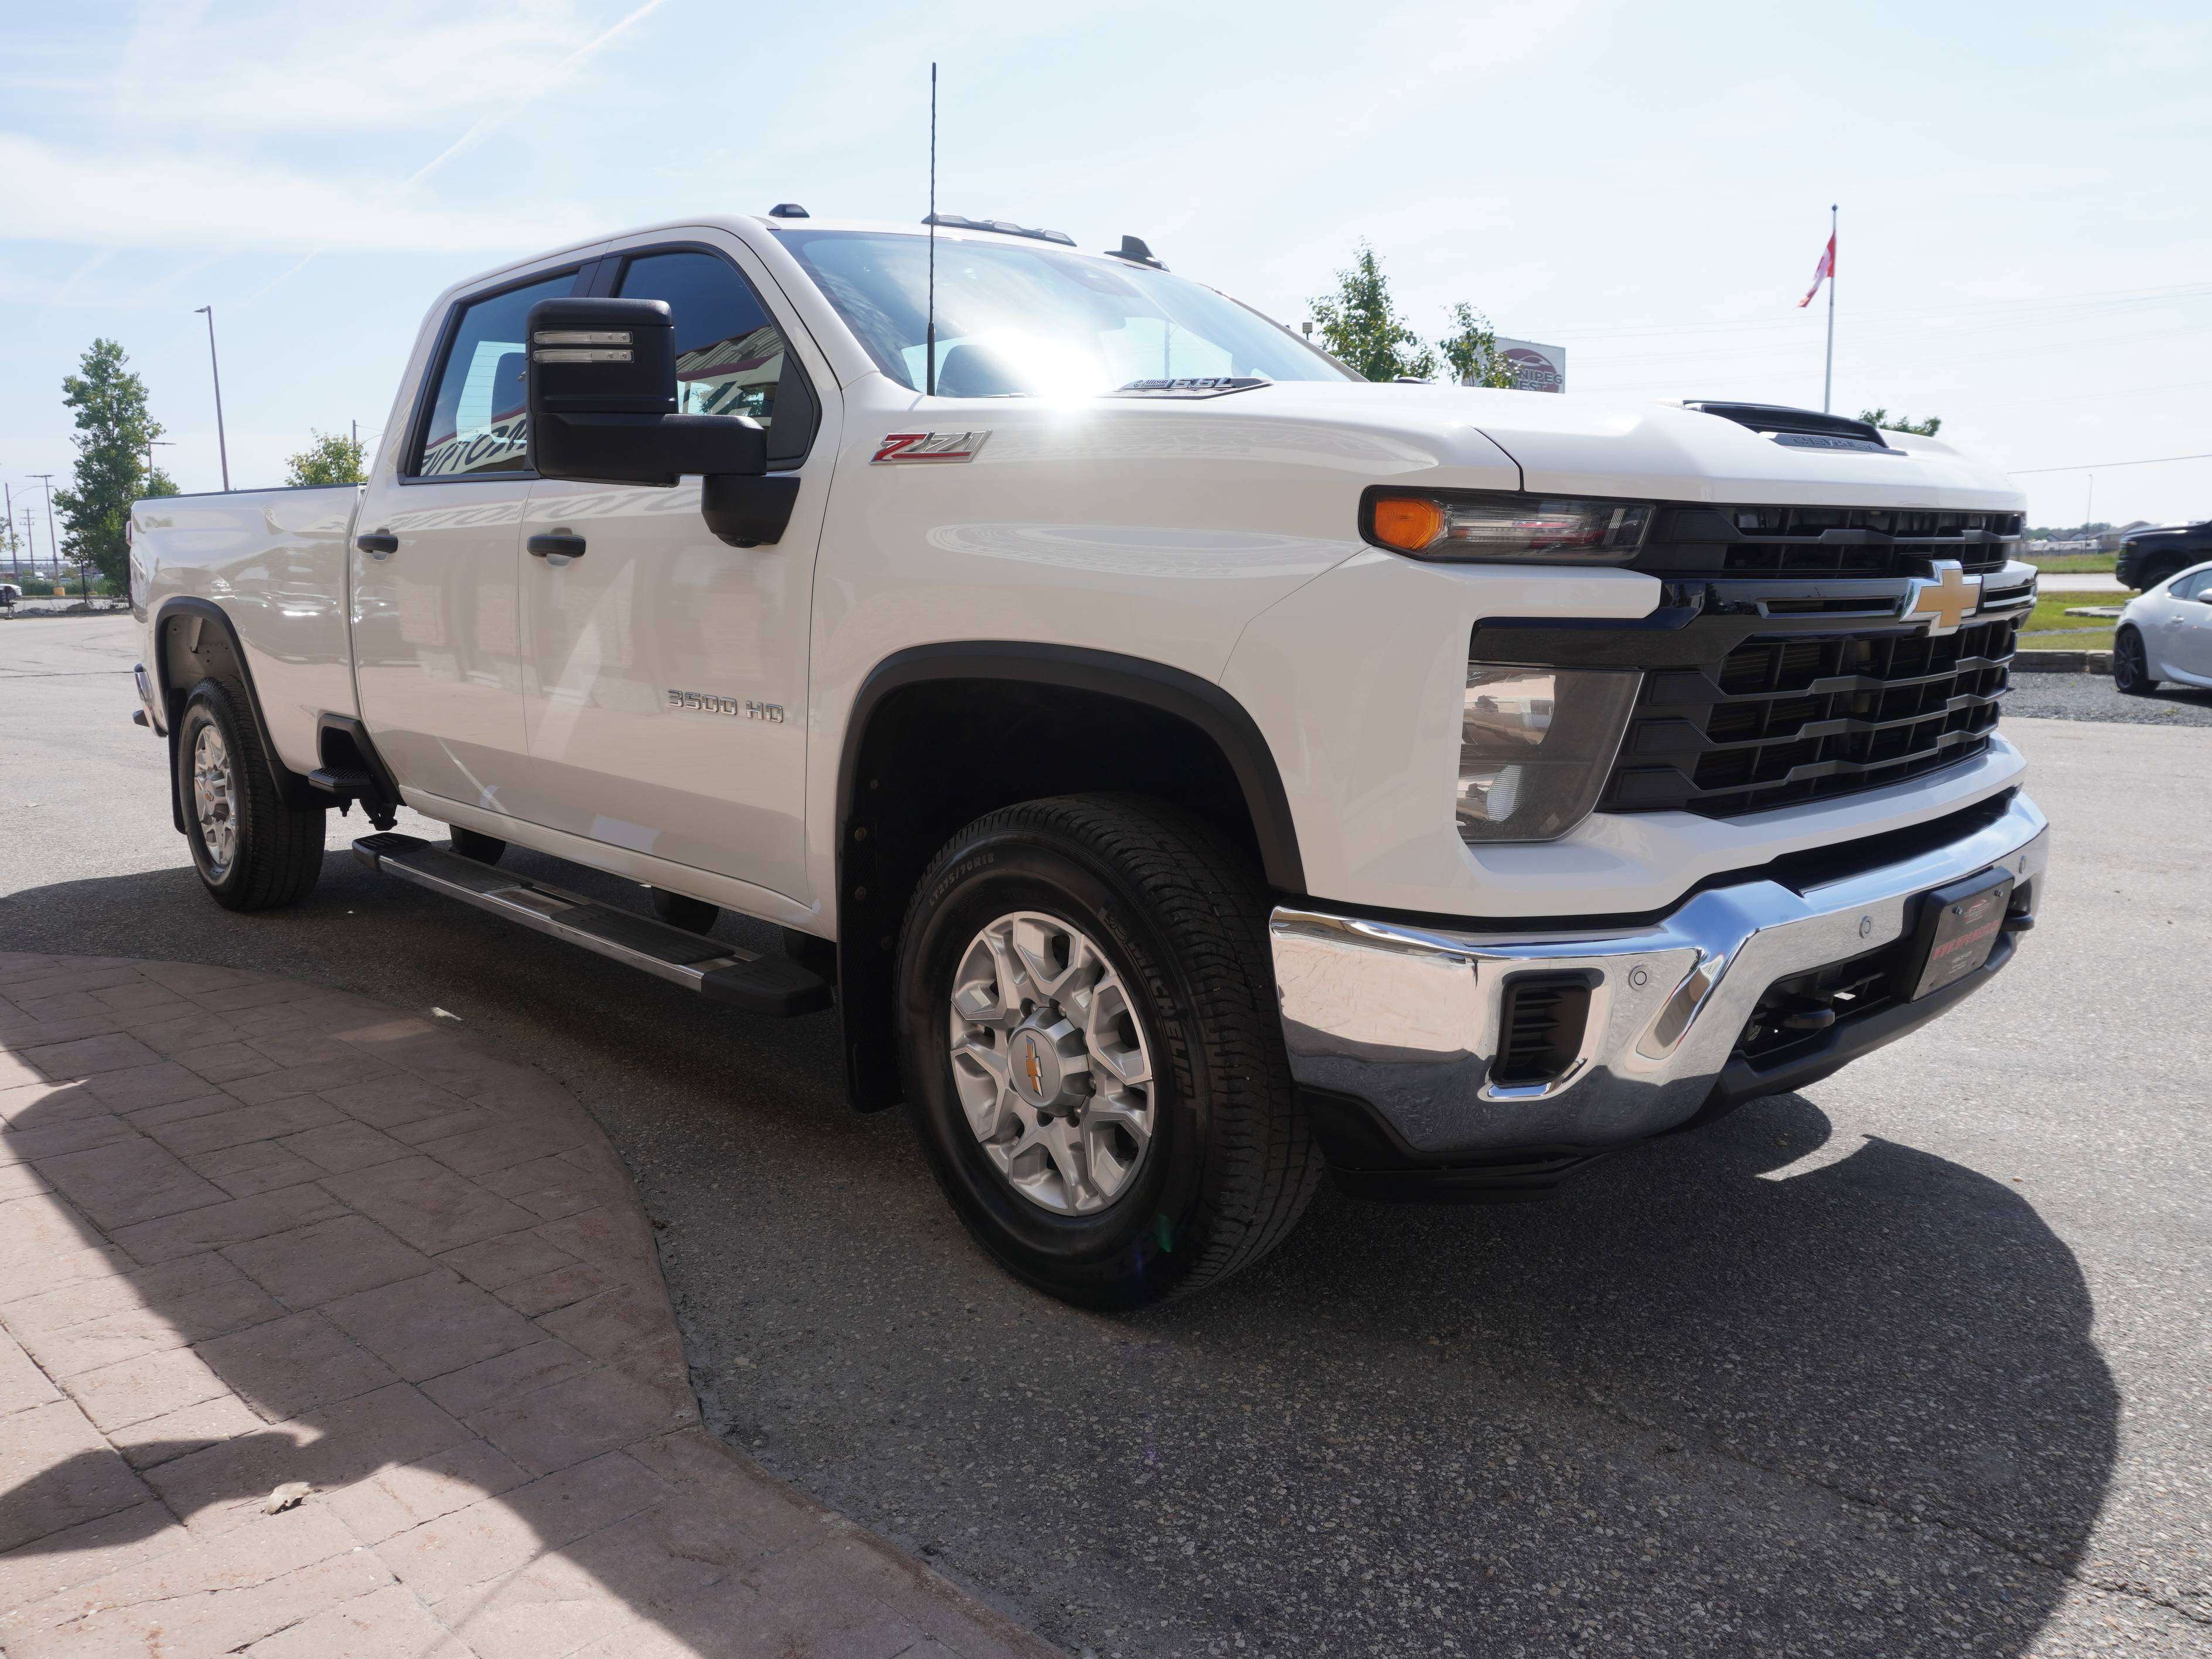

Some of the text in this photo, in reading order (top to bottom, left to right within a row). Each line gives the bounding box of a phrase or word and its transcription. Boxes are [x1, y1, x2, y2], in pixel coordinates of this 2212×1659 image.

[1516, 367, 1564, 385] NIPEG
[869, 429, 992, 465] Z71
[1791, 436, 1873, 451] CHEVROLET
[668, 689, 784, 723] 3500 HD
[929, 853, 994, 907] LT275/70R18
[1124, 941, 1196, 1100] MICHELIN
